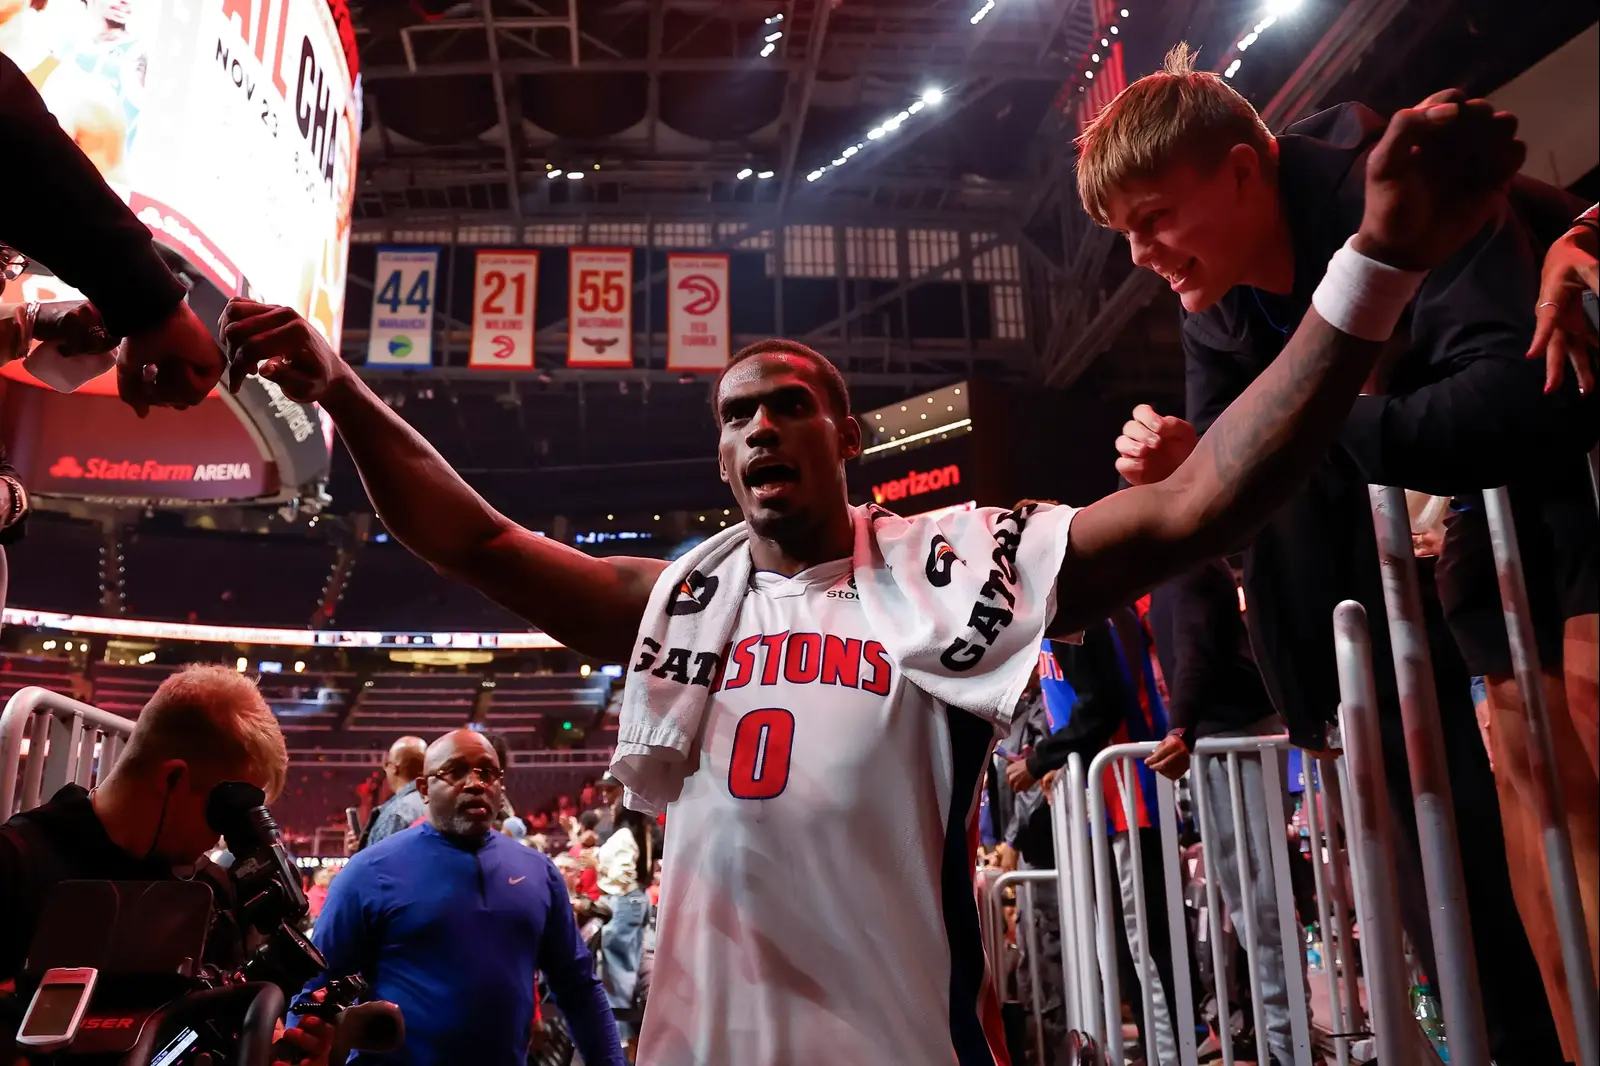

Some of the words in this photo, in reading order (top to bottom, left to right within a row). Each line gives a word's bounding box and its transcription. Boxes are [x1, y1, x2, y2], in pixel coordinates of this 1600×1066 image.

[216, 37, 255, 101] NOV
[296, 34, 337, 200] CHA
[377, 269, 430, 313] 44
[482, 270, 526, 315] 21
[578, 269, 625, 313] 55
[193, 463, 251, 482] ARENA
[872, 464, 961, 504] verizon
[728, 708, 795, 800] 0
